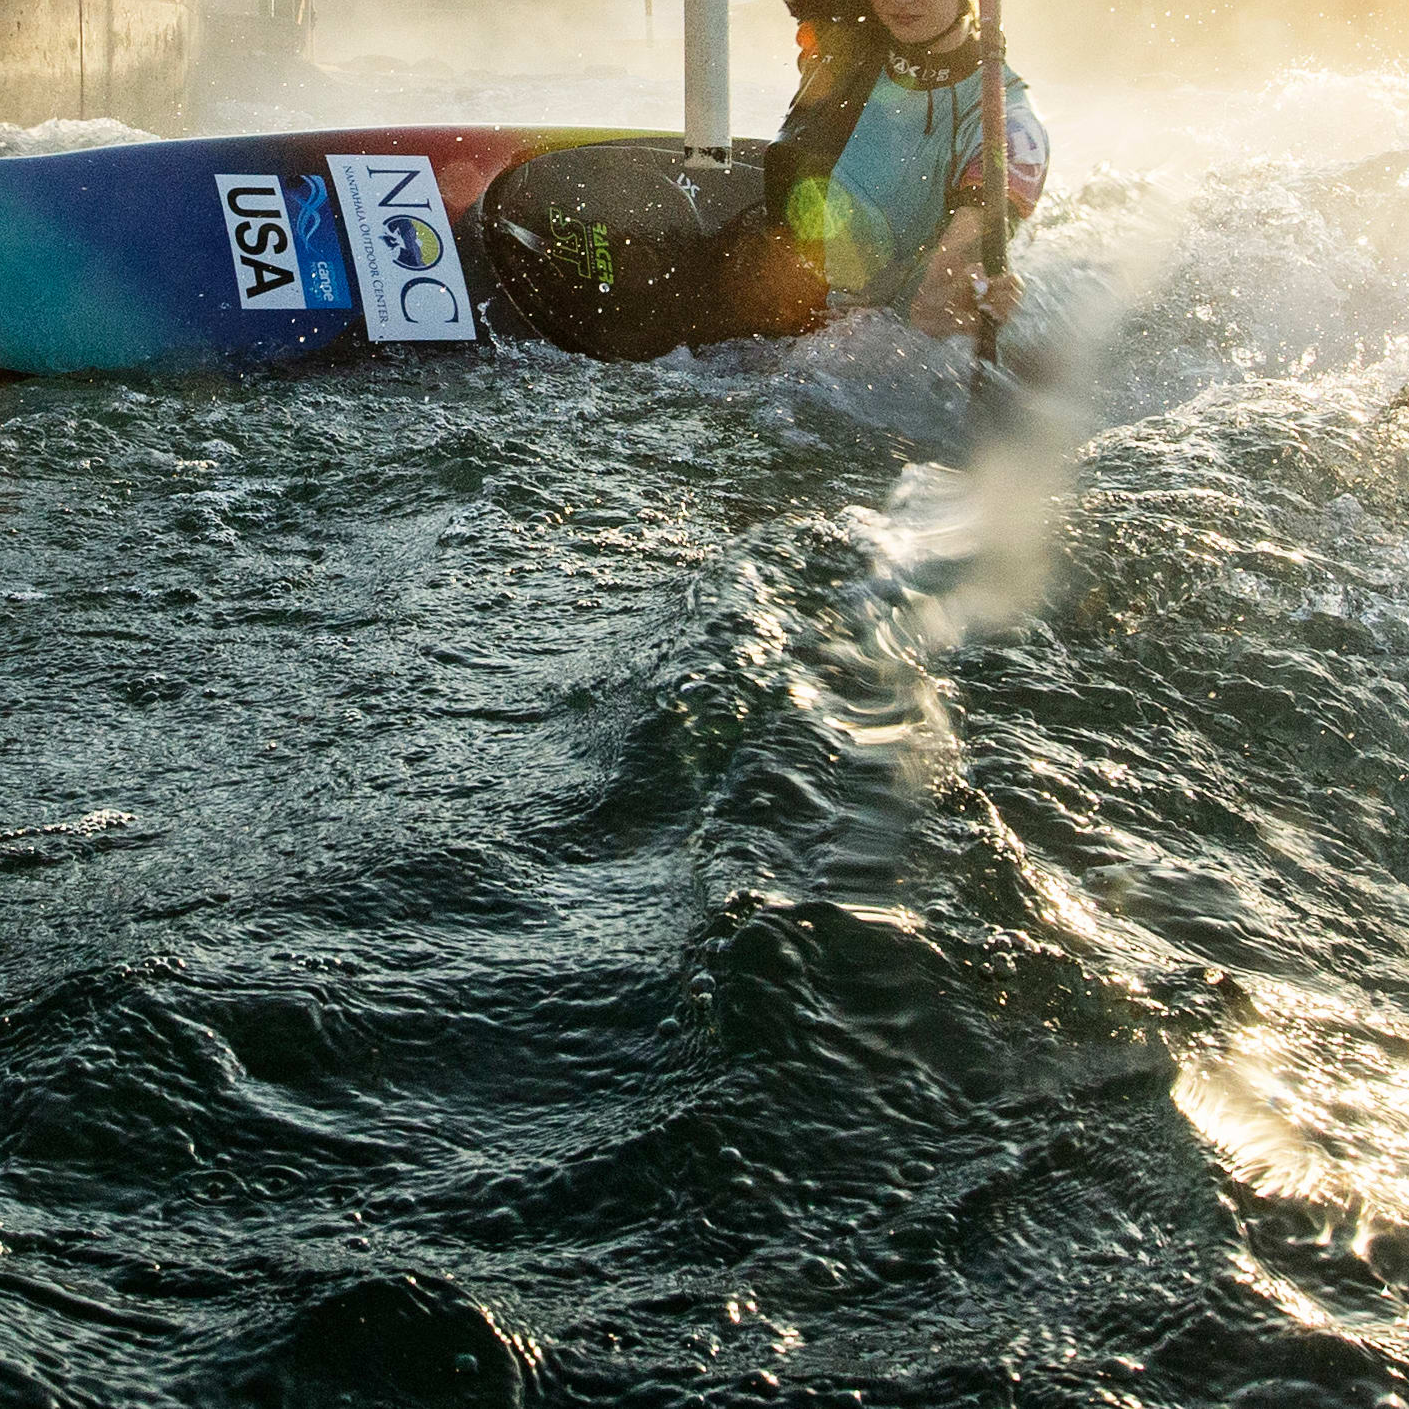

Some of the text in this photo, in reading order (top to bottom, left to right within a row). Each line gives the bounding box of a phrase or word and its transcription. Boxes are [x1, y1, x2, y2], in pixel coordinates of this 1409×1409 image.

[227, 187, 295, 299] USA
[343, 165, 389, 324] NANTAHALA OUTDOOR CENTER
[366, 165, 459, 324] NOC
[593, 222, 614, 285] RACER
